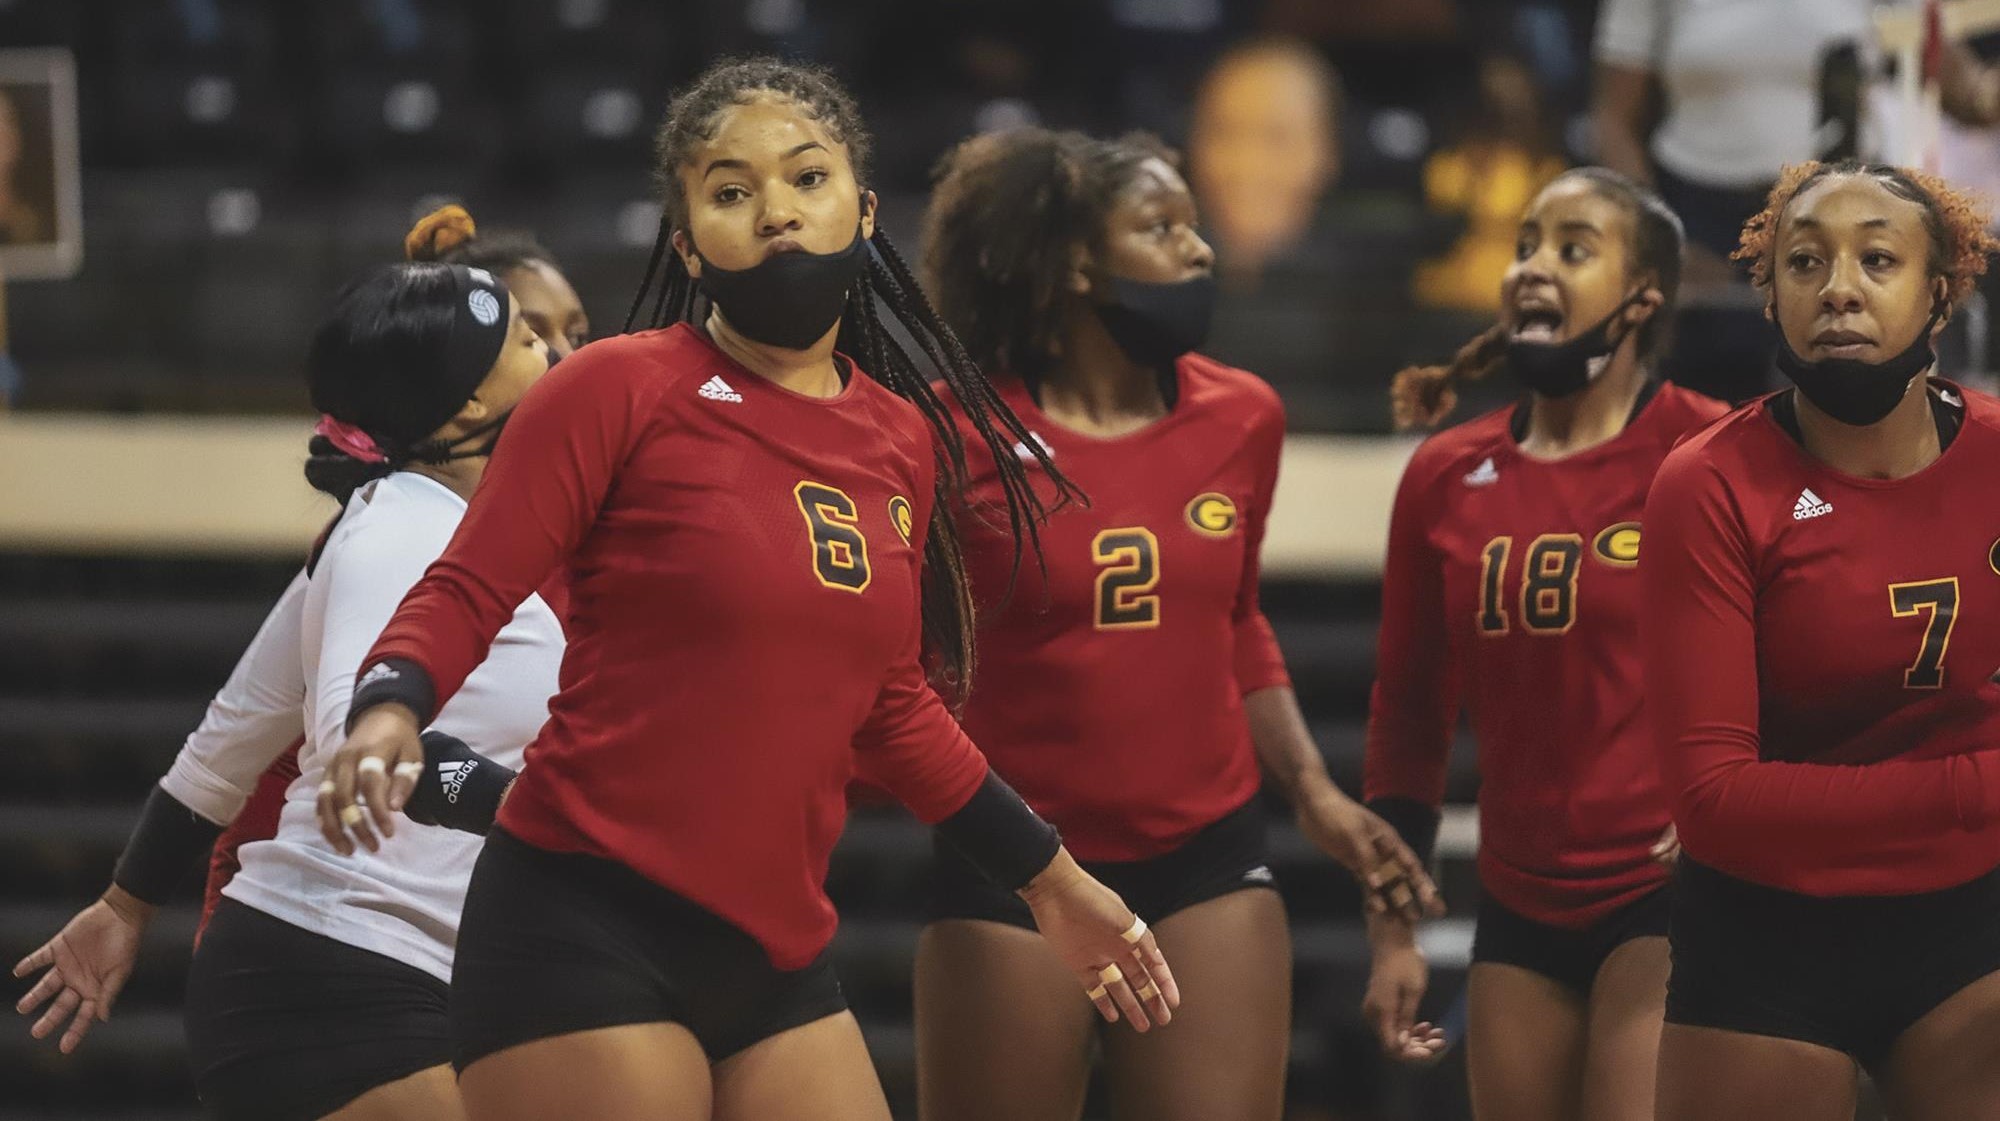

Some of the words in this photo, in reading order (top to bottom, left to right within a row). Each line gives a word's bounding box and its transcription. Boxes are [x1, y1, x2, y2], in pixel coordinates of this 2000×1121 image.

[698, 388, 743, 403] adidas
[793, 480, 871, 594] 6
[1197, 498, 1237, 533] G
[1793, 503, 1833, 520] adidas
[1091, 526, 1160, 631] 2
[1476, 533, 1583, 636] 18
[1888, 576, 1960, 689] 7
[448, 759, 479, 804] adidas
